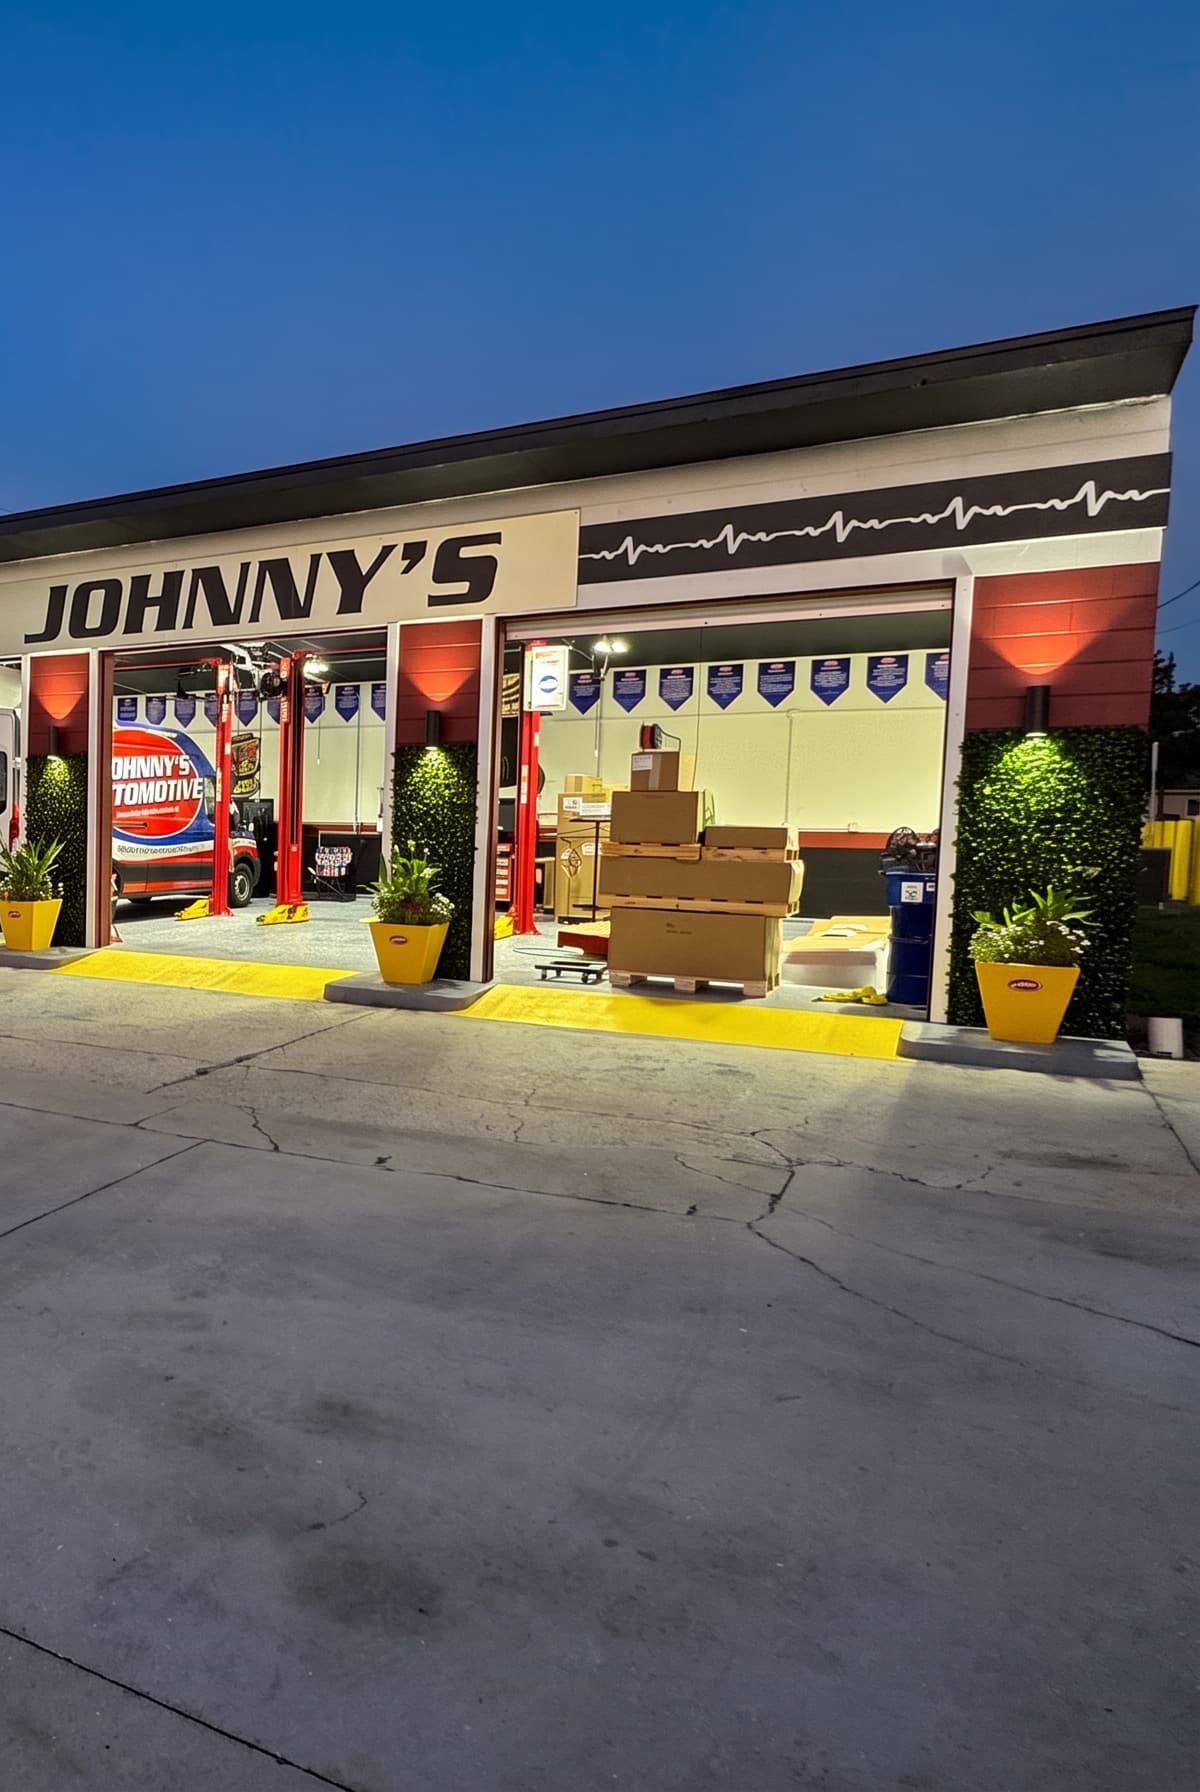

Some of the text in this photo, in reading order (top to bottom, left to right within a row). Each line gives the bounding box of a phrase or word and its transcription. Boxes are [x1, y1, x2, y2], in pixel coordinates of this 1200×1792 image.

[24, 531, 502, 644] JOHNNY'S
[111, 754, 191, 780] OHNNY'S
[111, 777, 204, 806] TOMOTIVE
